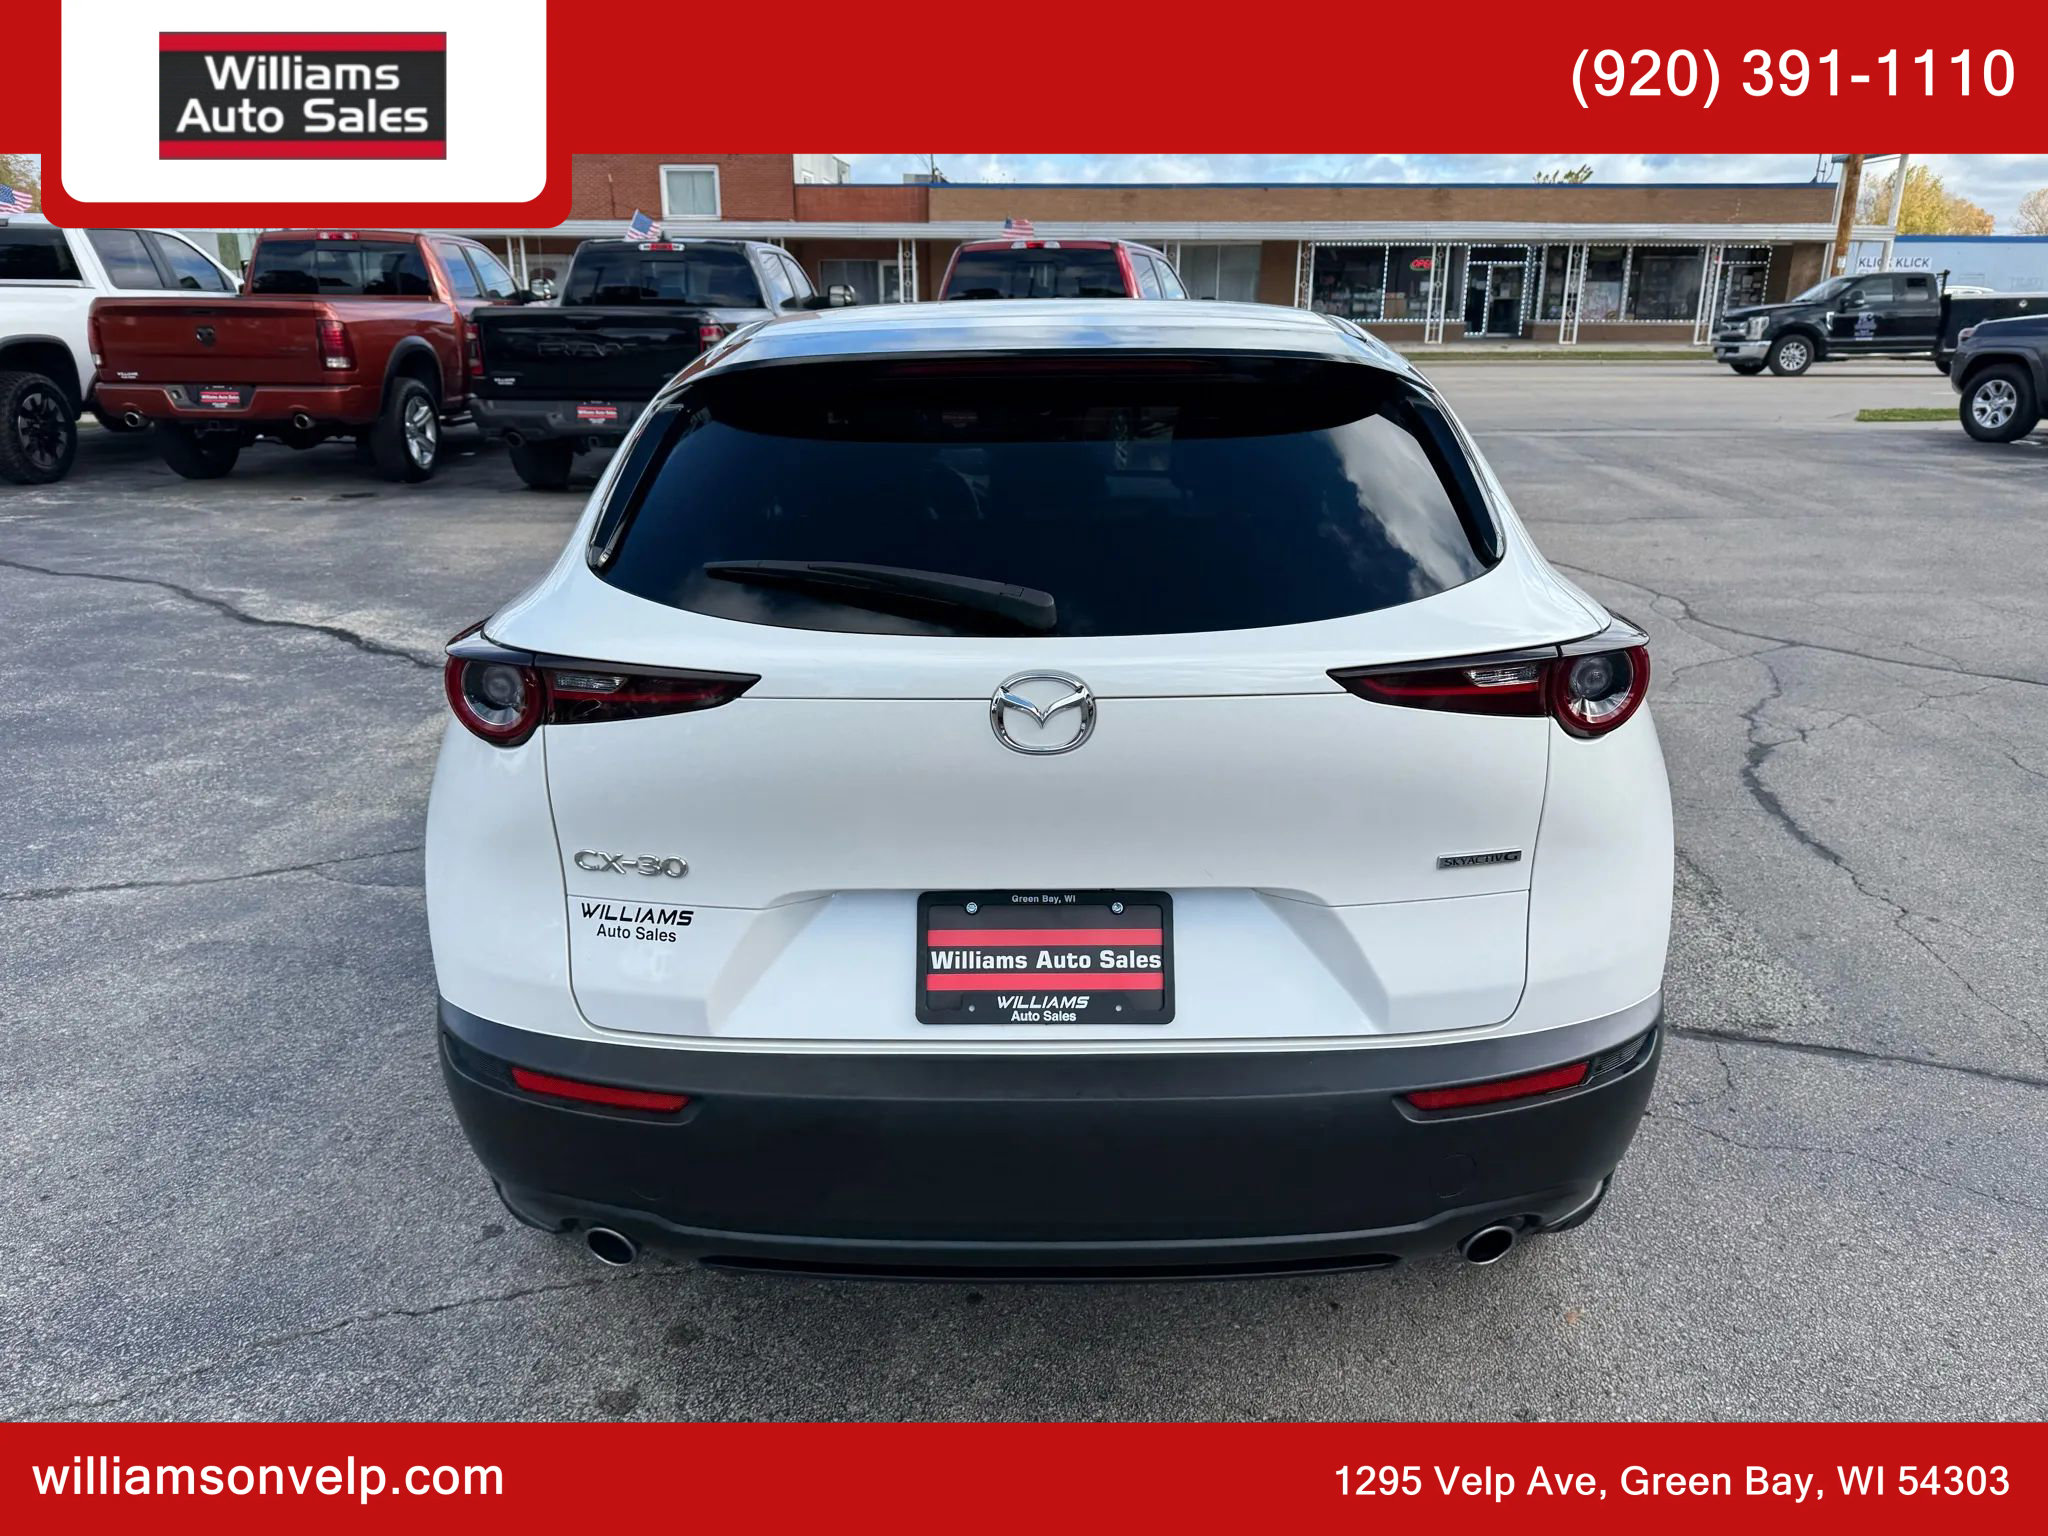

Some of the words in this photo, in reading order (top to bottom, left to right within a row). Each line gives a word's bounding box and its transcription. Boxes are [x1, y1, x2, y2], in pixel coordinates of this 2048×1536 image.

[1895, 257, 1930, 268] KLICK
[574, 849, 689, 879] CX-30
[1011, 894, 1039, 904] Green
[1042, 894, 1062, 905] Bay,
[1064, 894, 1076, 904] WI
[581, 902, 694, 926] WILLIAMS
[596, 923, 631, 939] Auto
[635, 926, 677, 942] Sales
[930, 950, 1028, 970] Williams
[1035, 950, 1092, 969] Auto
[1099, 949, 1162, 969] Sales
[997, 995, 1090, 1009] WILLIAMS
[1010, 1010, 1040, 1022] Auto
[1043, 1010, 1077, 1022] Sales
